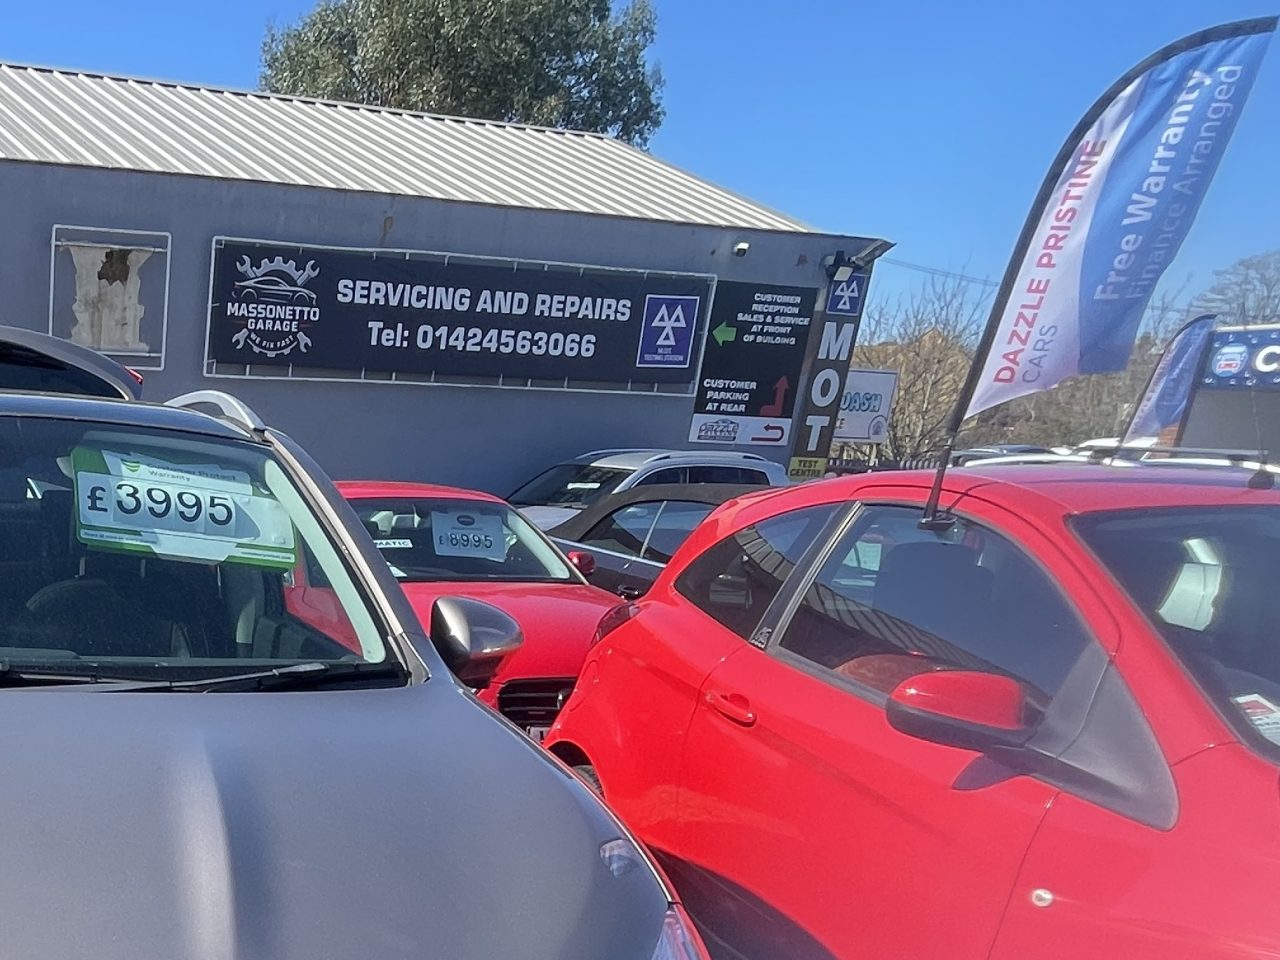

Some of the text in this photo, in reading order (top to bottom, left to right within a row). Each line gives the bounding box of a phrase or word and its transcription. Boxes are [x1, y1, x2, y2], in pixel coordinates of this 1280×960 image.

[1094, 68, 1213, 300] Free Warranty
[1125, 202, 1185, 299] Finance
[1172, 65, 1243, 195] Arranged
[993, 139, 1108, 385] DAZZLE PRISTINE
[336, 279, 632, 322] SERVICING AND REPAIRS
[754, 293, 801, 303] CUSTOMER
[227, 302, 320, 321] MASSONETTO
[752, 304, 799, 313] RECEPTION
[248, 319, 298, 331] GARAGE
[737, 313, 764, 322] SALES
[774, 316, 810, 325] SERVICE
[751, 324, 792, 334] AT FRONT
[250, 332, 294, 348] WE FIX FAST
[367, 321, 597, 358] Tel: 01424563066
[743, 334, 796, 344] OF BUILDING
[1022, 324, 1058, 384] CARS
[703, 379, 757, 389] CUSTOMER
[706, 391, 749, 401] PARKING
[706, 402, 746, 412] AT REAR
[798, 460, 819, 468] TEST
[87, 484, 233, 525] £3995
